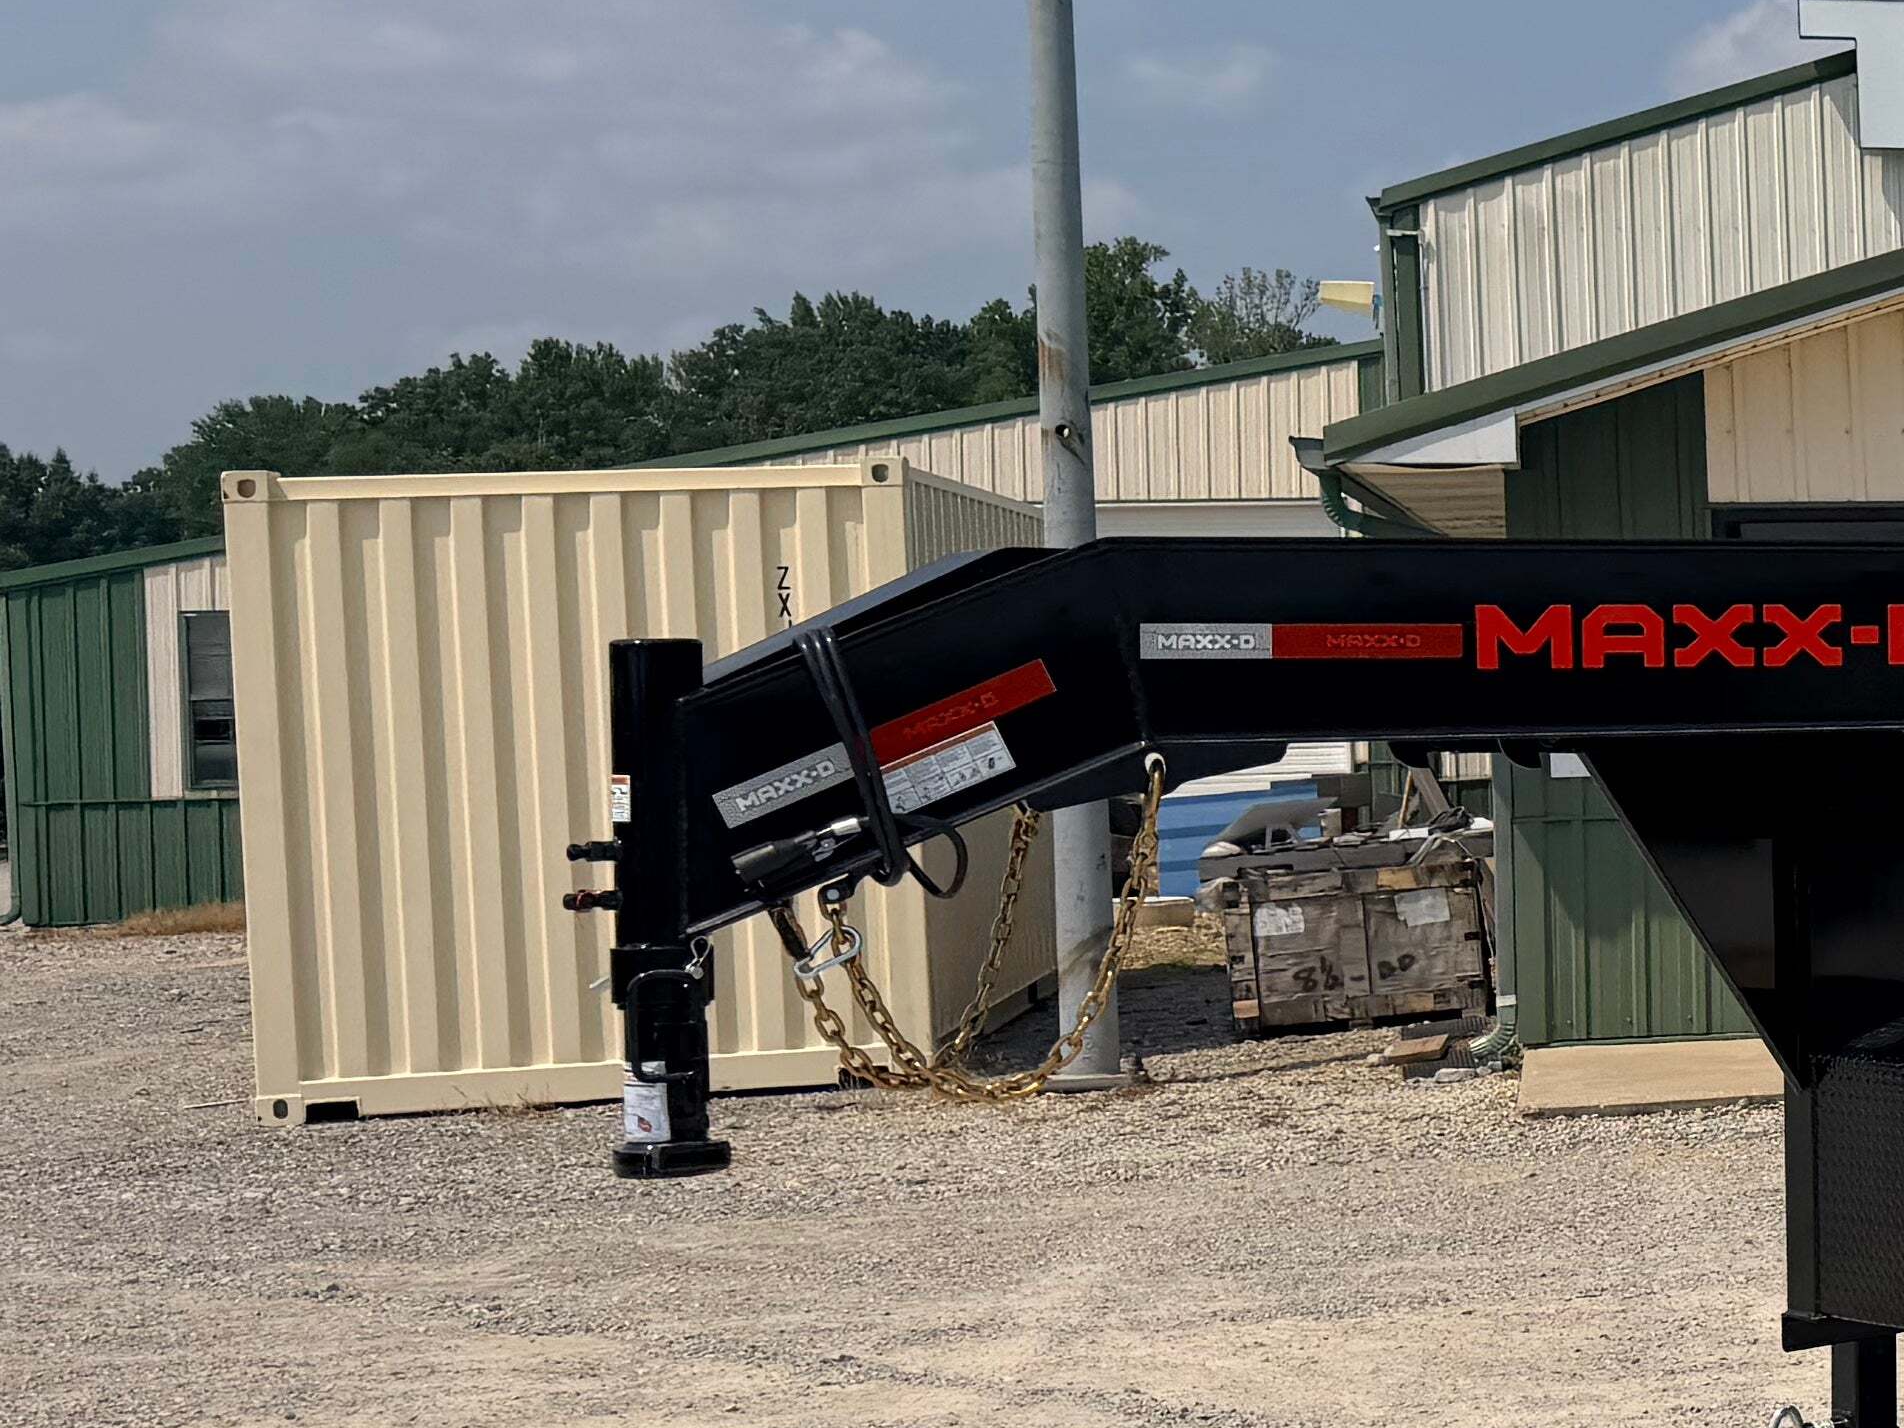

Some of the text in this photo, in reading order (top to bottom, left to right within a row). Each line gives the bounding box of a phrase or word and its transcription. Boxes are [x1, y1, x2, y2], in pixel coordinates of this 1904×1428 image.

[1156, 634, 1257, 650] MAXX-D
[1326, 634, 1421, 648] MAXX-D
[735, 759, 836, 812] MAXX-D
